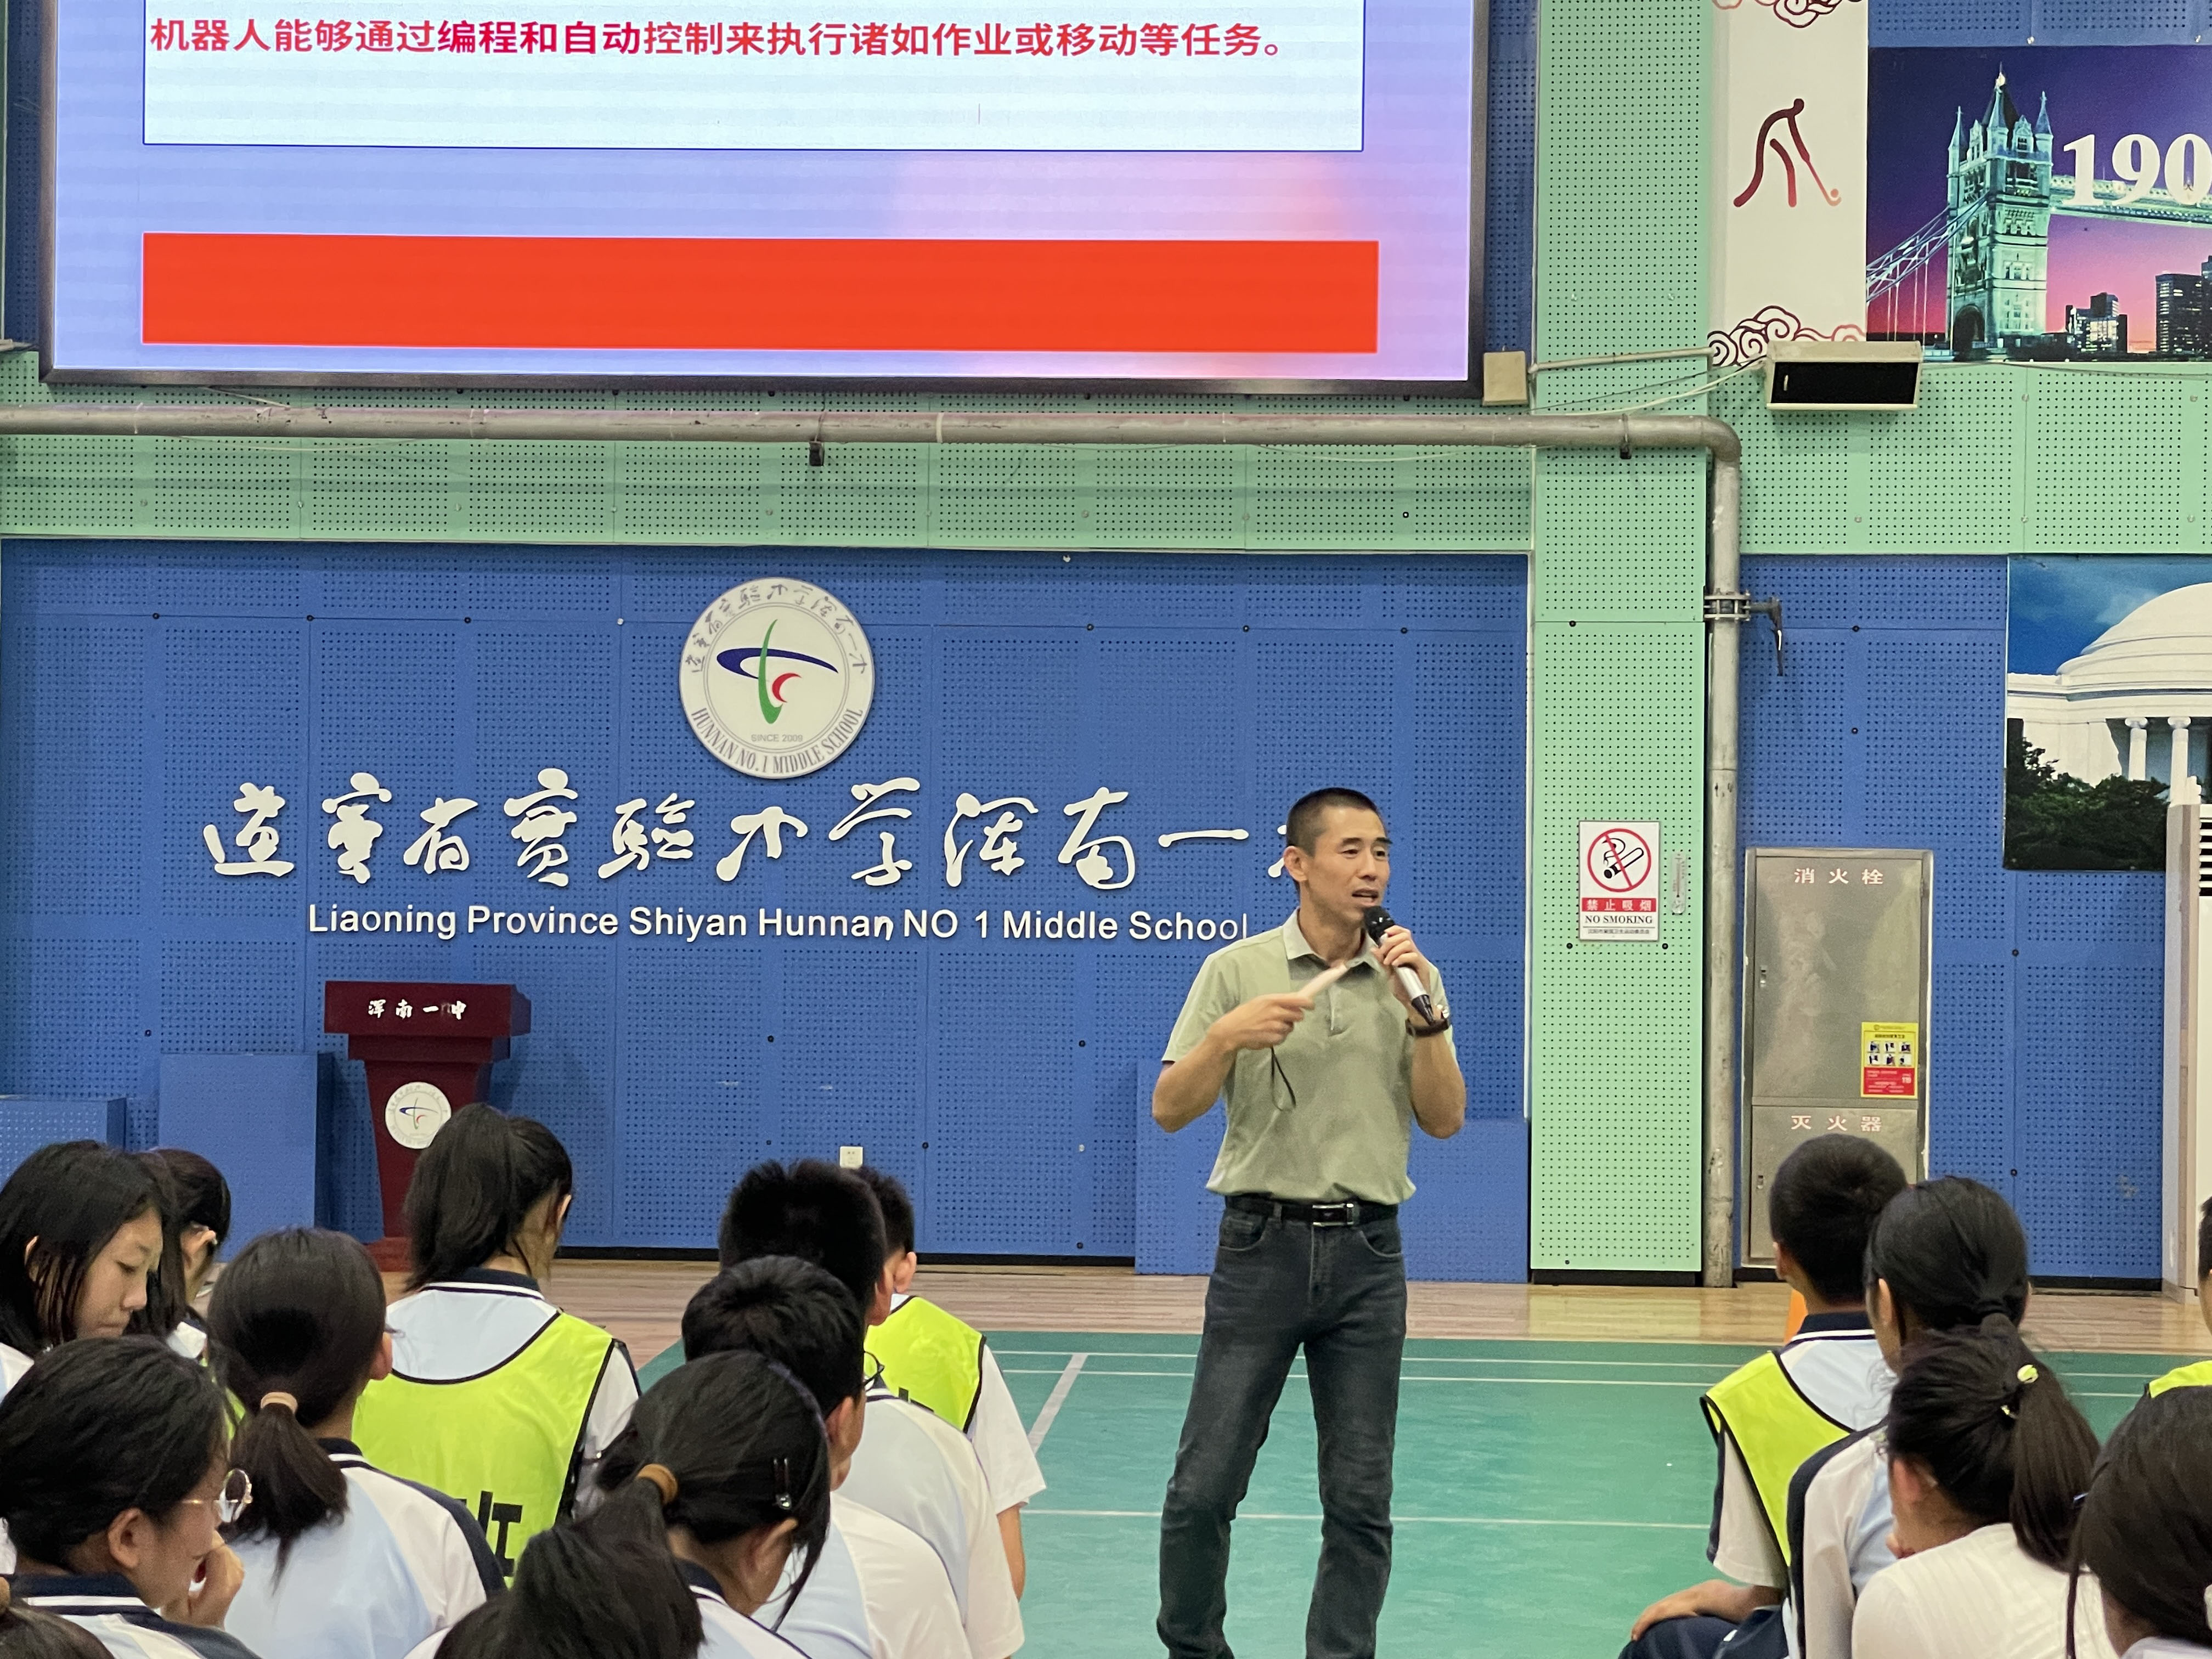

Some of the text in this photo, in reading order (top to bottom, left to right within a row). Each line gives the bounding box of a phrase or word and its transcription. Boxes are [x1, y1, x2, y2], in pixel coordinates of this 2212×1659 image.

[150, 18, 1279, 57] 机器人能够通过编程和自动控制来执行诸如作业或移动等任务。
[691, 707, 739, 760] HUNNAN
[772, 744, 825, 774] MIDDLE
[821, 708, 864, 754] SCHOOL
[782, 734, 803, 742] 2009
[1794, 867, 1883, 885] 消火栓
[1587, 899, 1652, 911] 禁止吸烟
[309, 904, 1247, 943] Liaoning Province Shiyan Hunnan NO 1 Middle School
[1585, 915, 1652, 924] NO SMOKING
[1791, 1115, 1882, 1132] 灭火器
